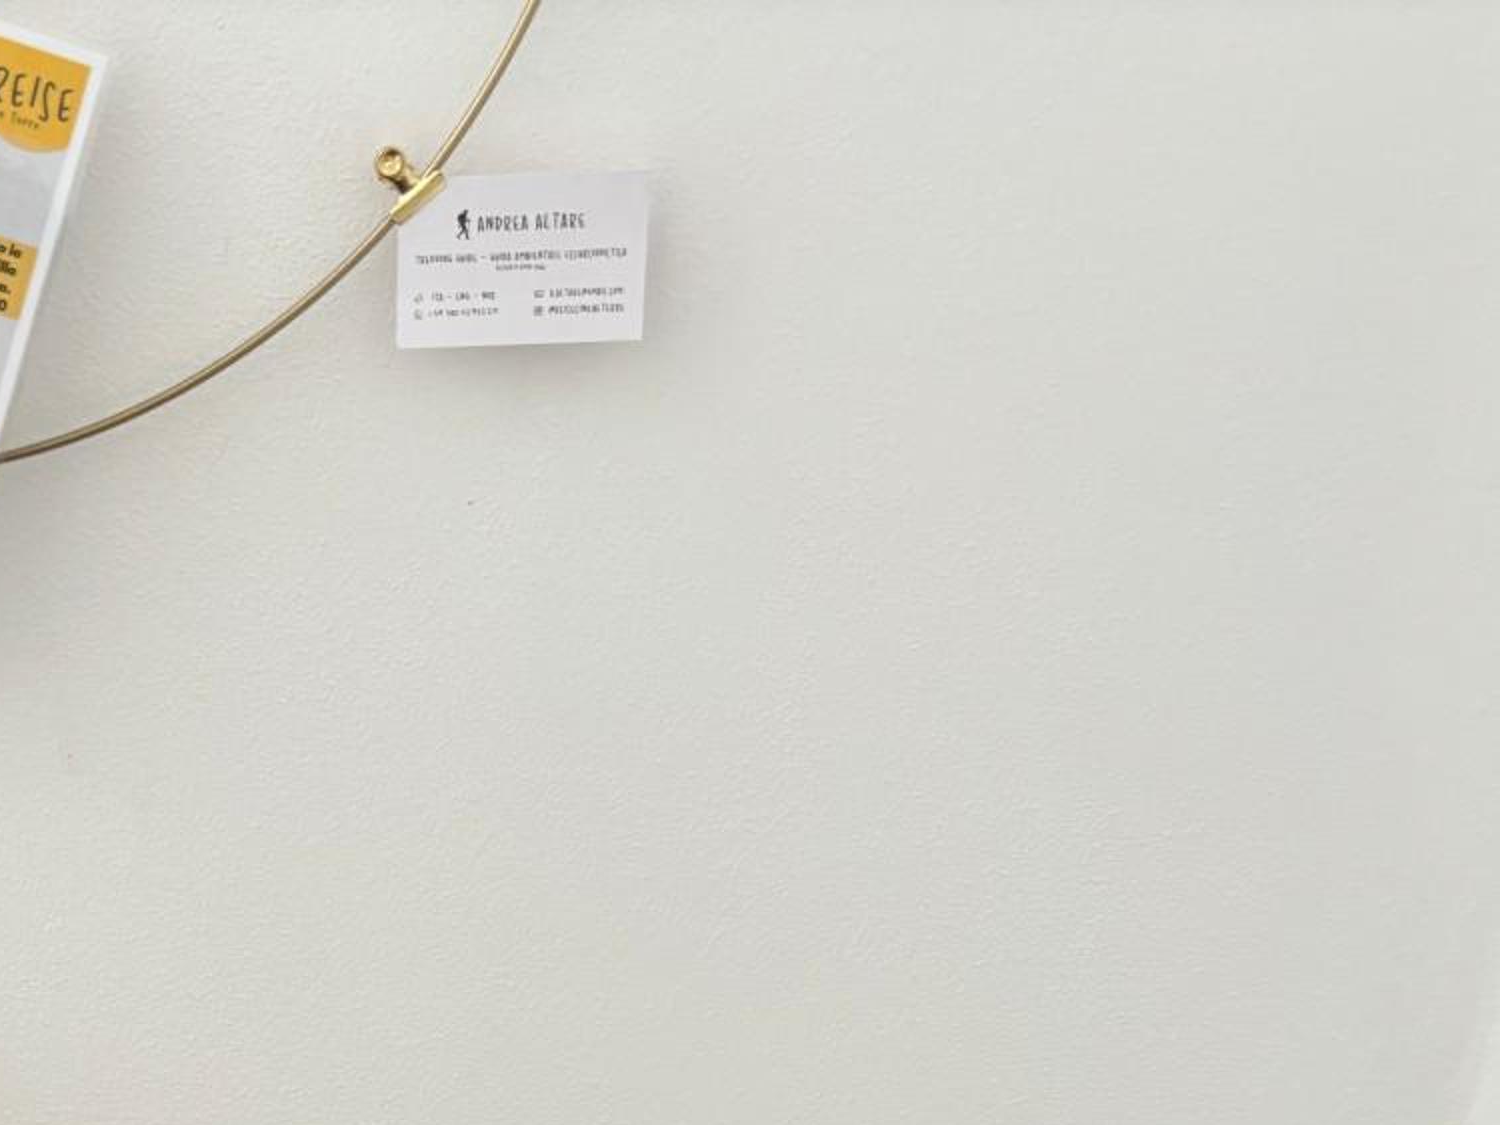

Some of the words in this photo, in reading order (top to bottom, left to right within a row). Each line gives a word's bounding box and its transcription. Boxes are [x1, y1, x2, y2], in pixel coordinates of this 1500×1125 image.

[477, 213, 529, 232] ANDREA
[535, 211, 586, 231] ALTARE
[8, 243, 22, 259] la
